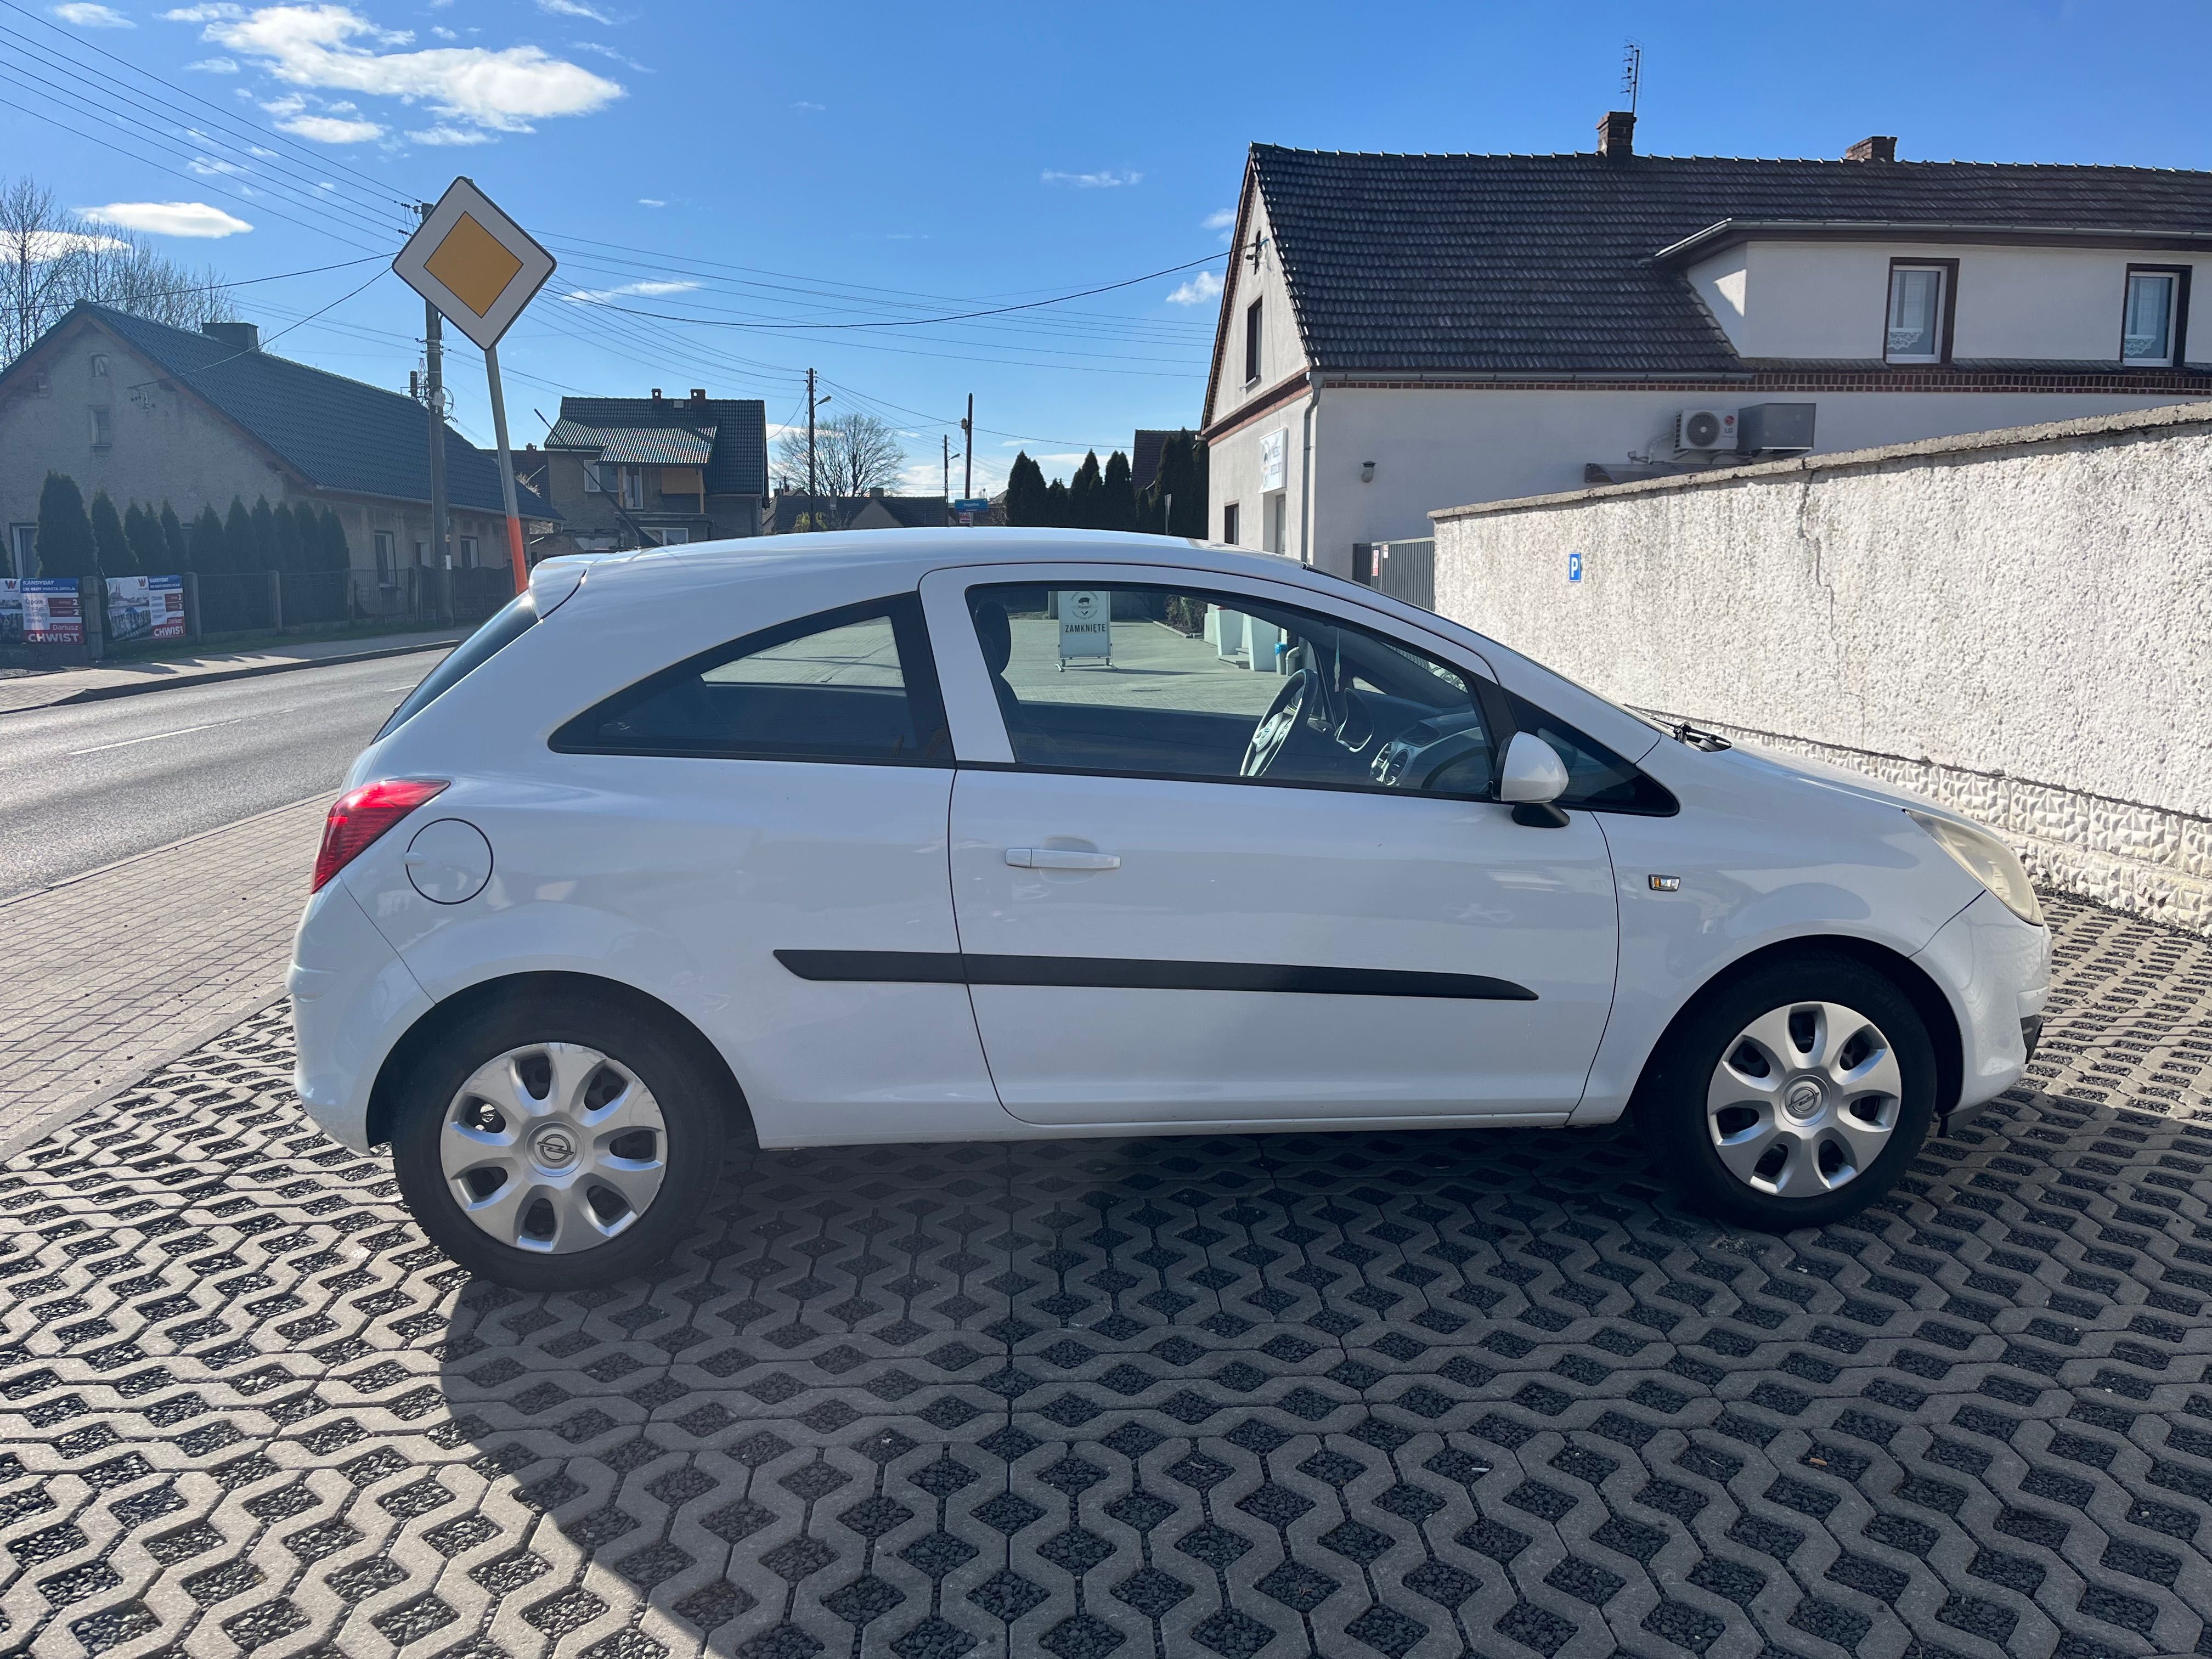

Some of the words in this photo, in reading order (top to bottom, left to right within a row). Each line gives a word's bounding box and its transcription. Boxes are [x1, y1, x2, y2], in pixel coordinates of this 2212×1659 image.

[1571, 557, 1578, 578] P
[154, 626, 184, 636] CHWIST
[1065, 624, 1106, 633] ZAMKNIĘTE
[28, 633, 79, 642] CHWIST
